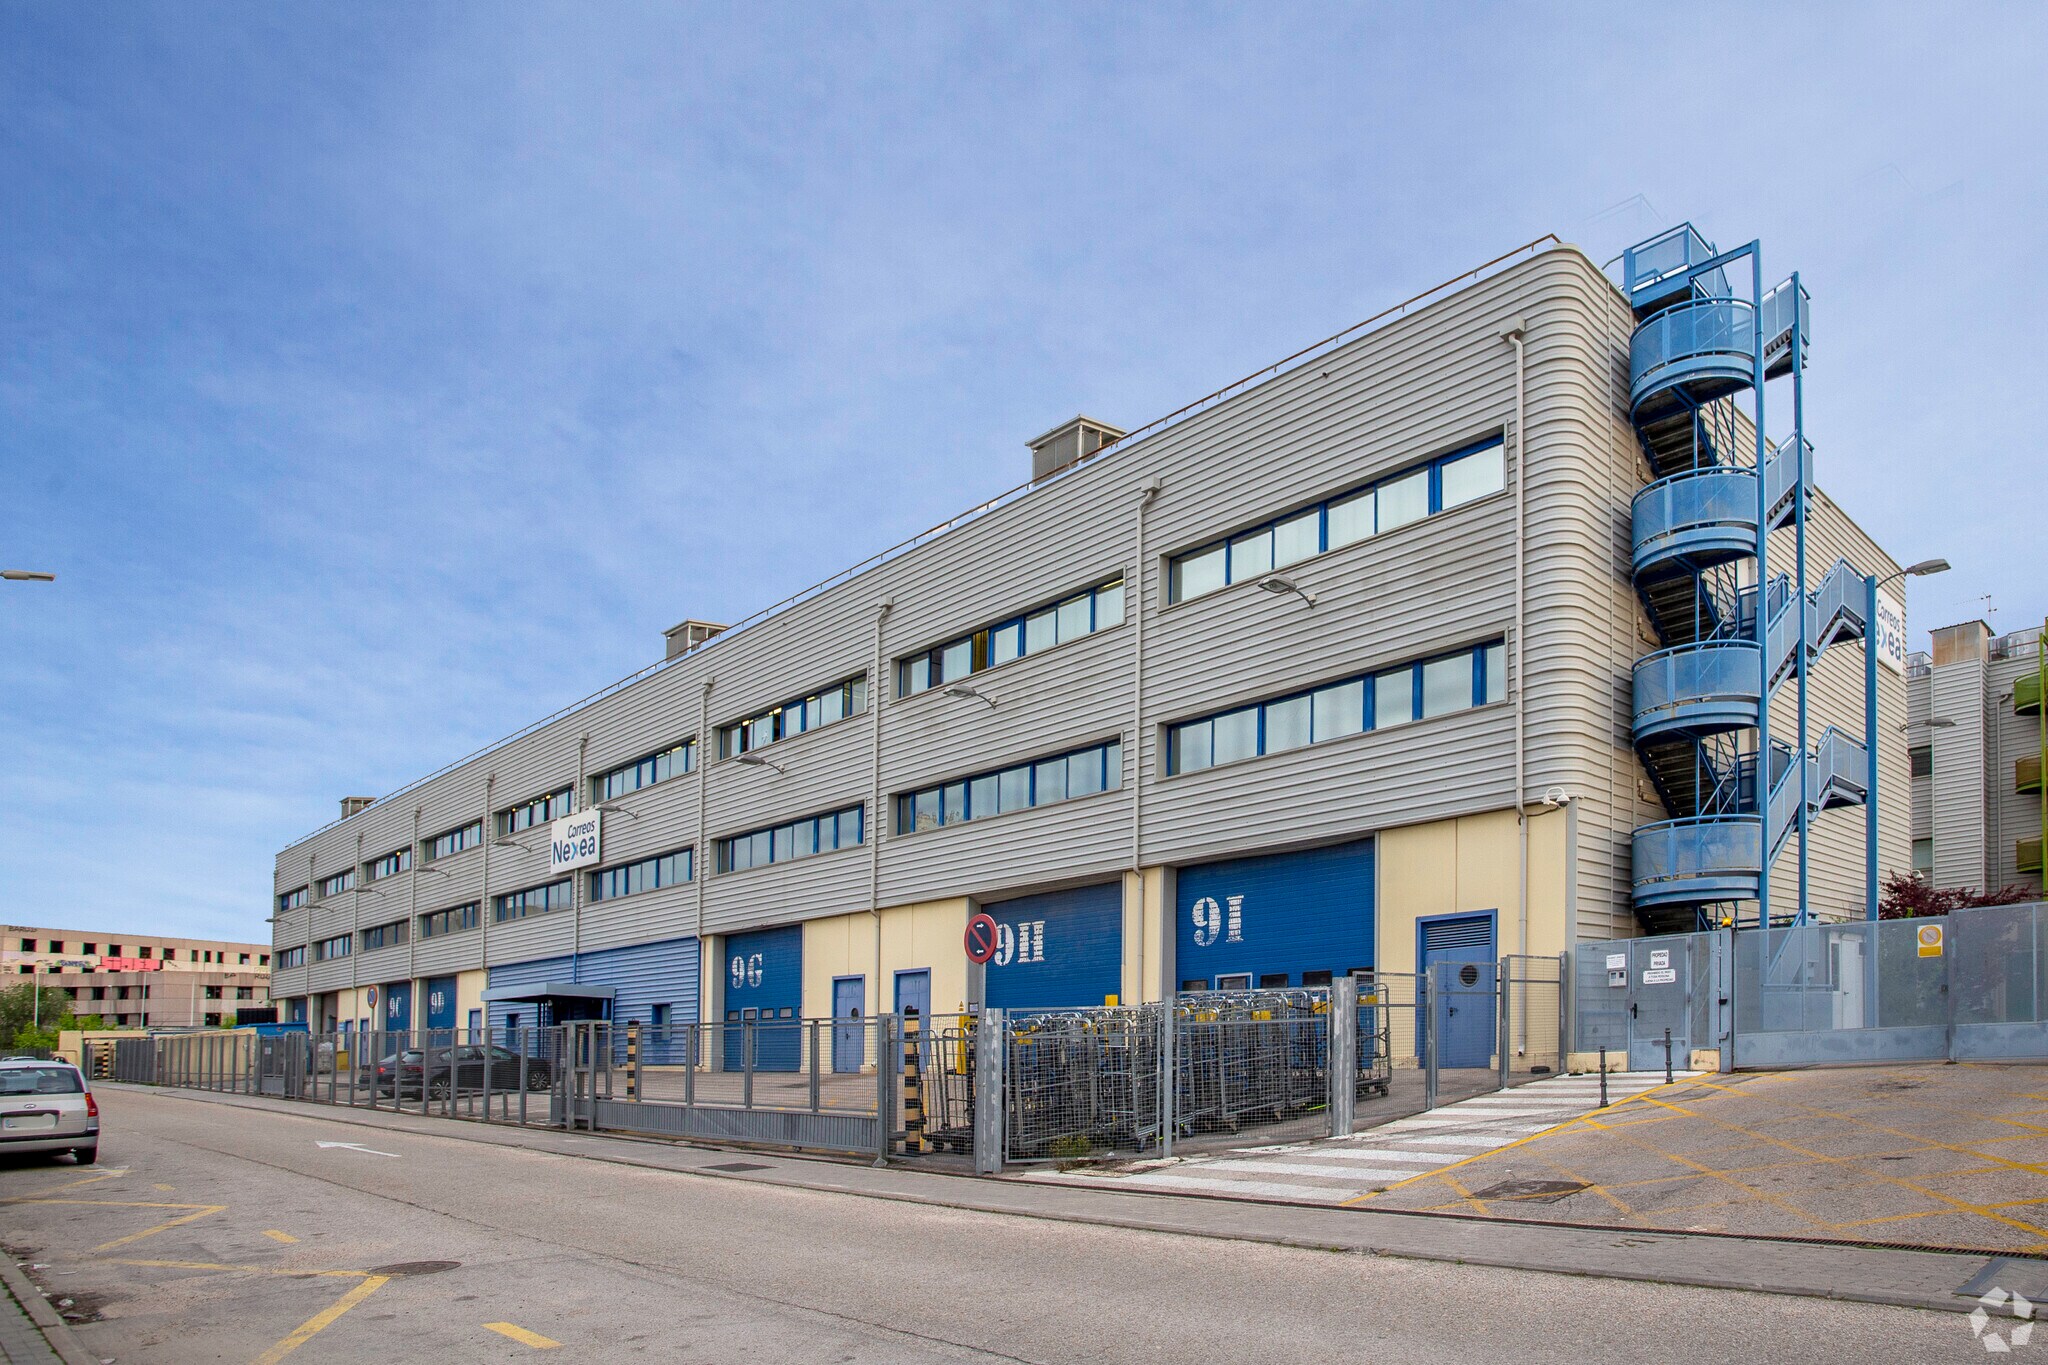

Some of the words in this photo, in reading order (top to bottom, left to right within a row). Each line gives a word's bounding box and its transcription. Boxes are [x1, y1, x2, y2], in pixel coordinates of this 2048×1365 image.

[1877, 599, 1901, 632] Correos
[567, 820, 595, 838] Correos
[553, 836, 595, 864] Nexea
[1192, 895, 1244, 946] 9I
[995, 920, 1045, 966] 9H
[732, 953, 763, 988] 9G
